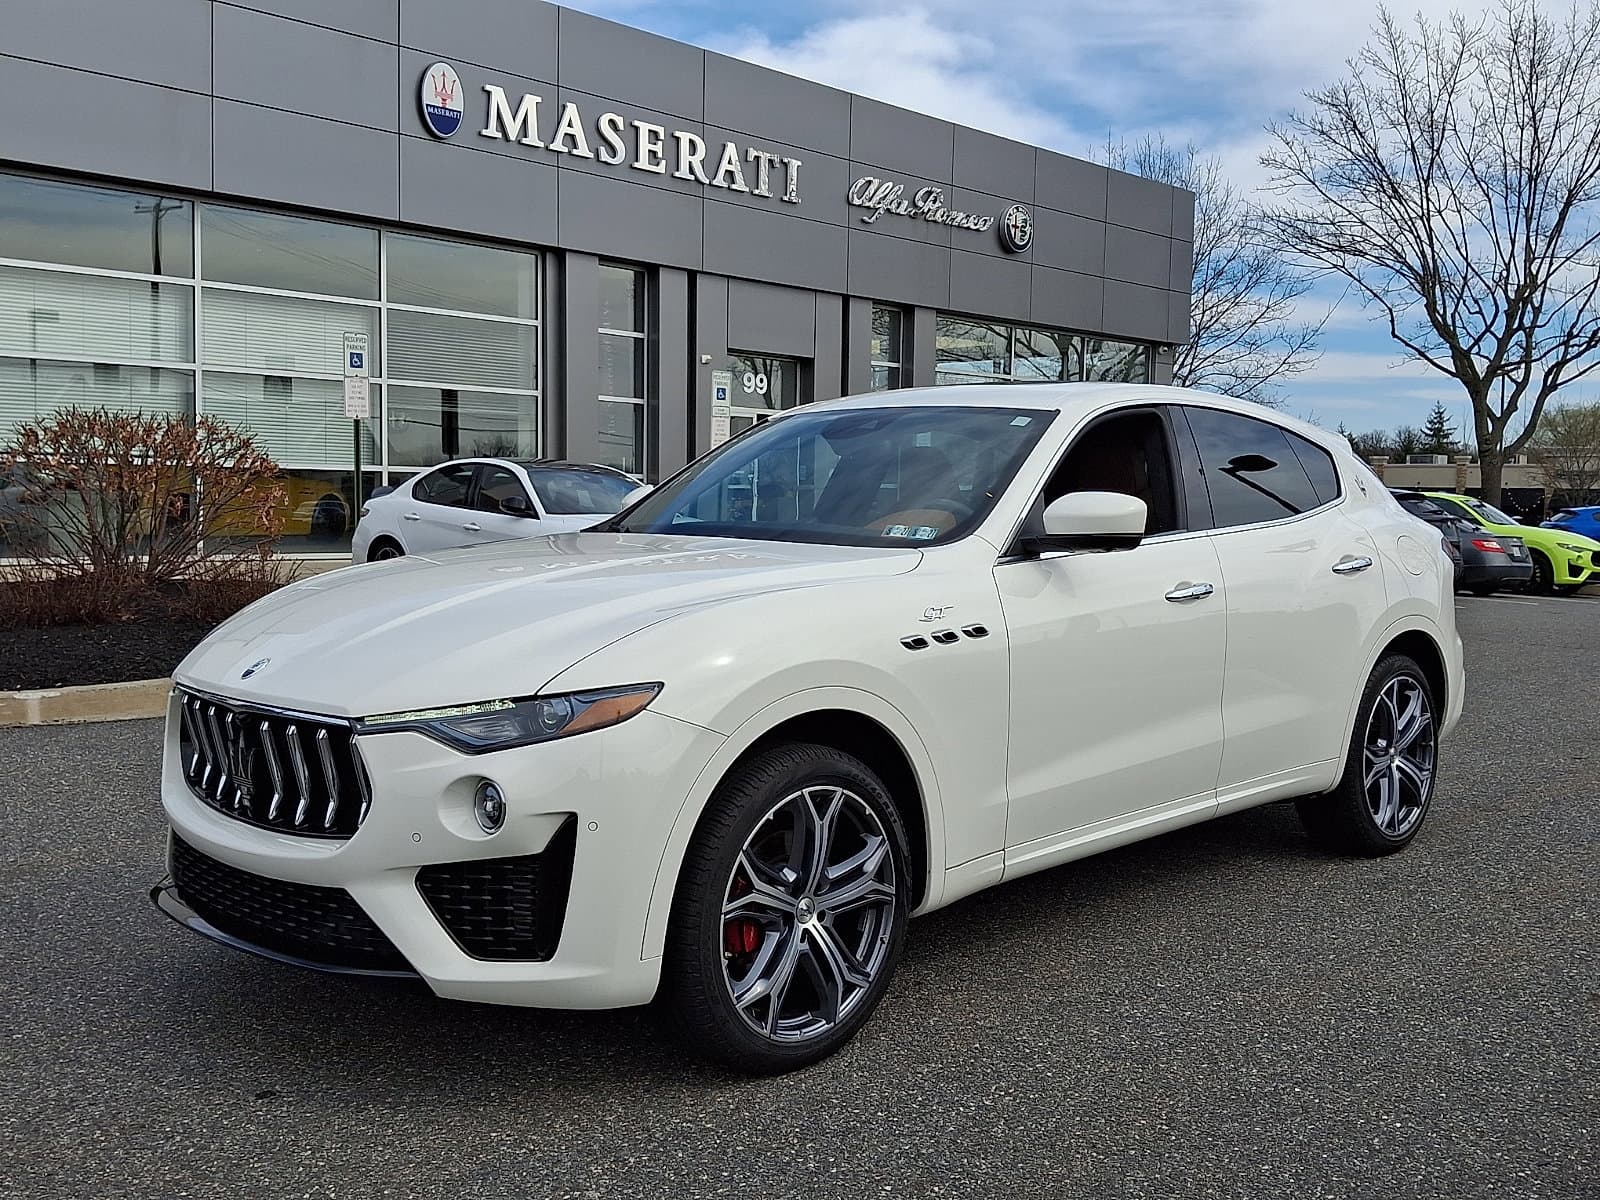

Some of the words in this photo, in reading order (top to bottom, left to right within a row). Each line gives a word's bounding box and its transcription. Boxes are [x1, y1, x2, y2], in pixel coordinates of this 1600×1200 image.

[427, 105, 460, 119] MASERATI
[481, 84, 802, 204] MASERATI
[849, 177, 912, 224] Alfa
[914, 186, 994, 231] Romeo
[743, 372, 767, 394] 99
